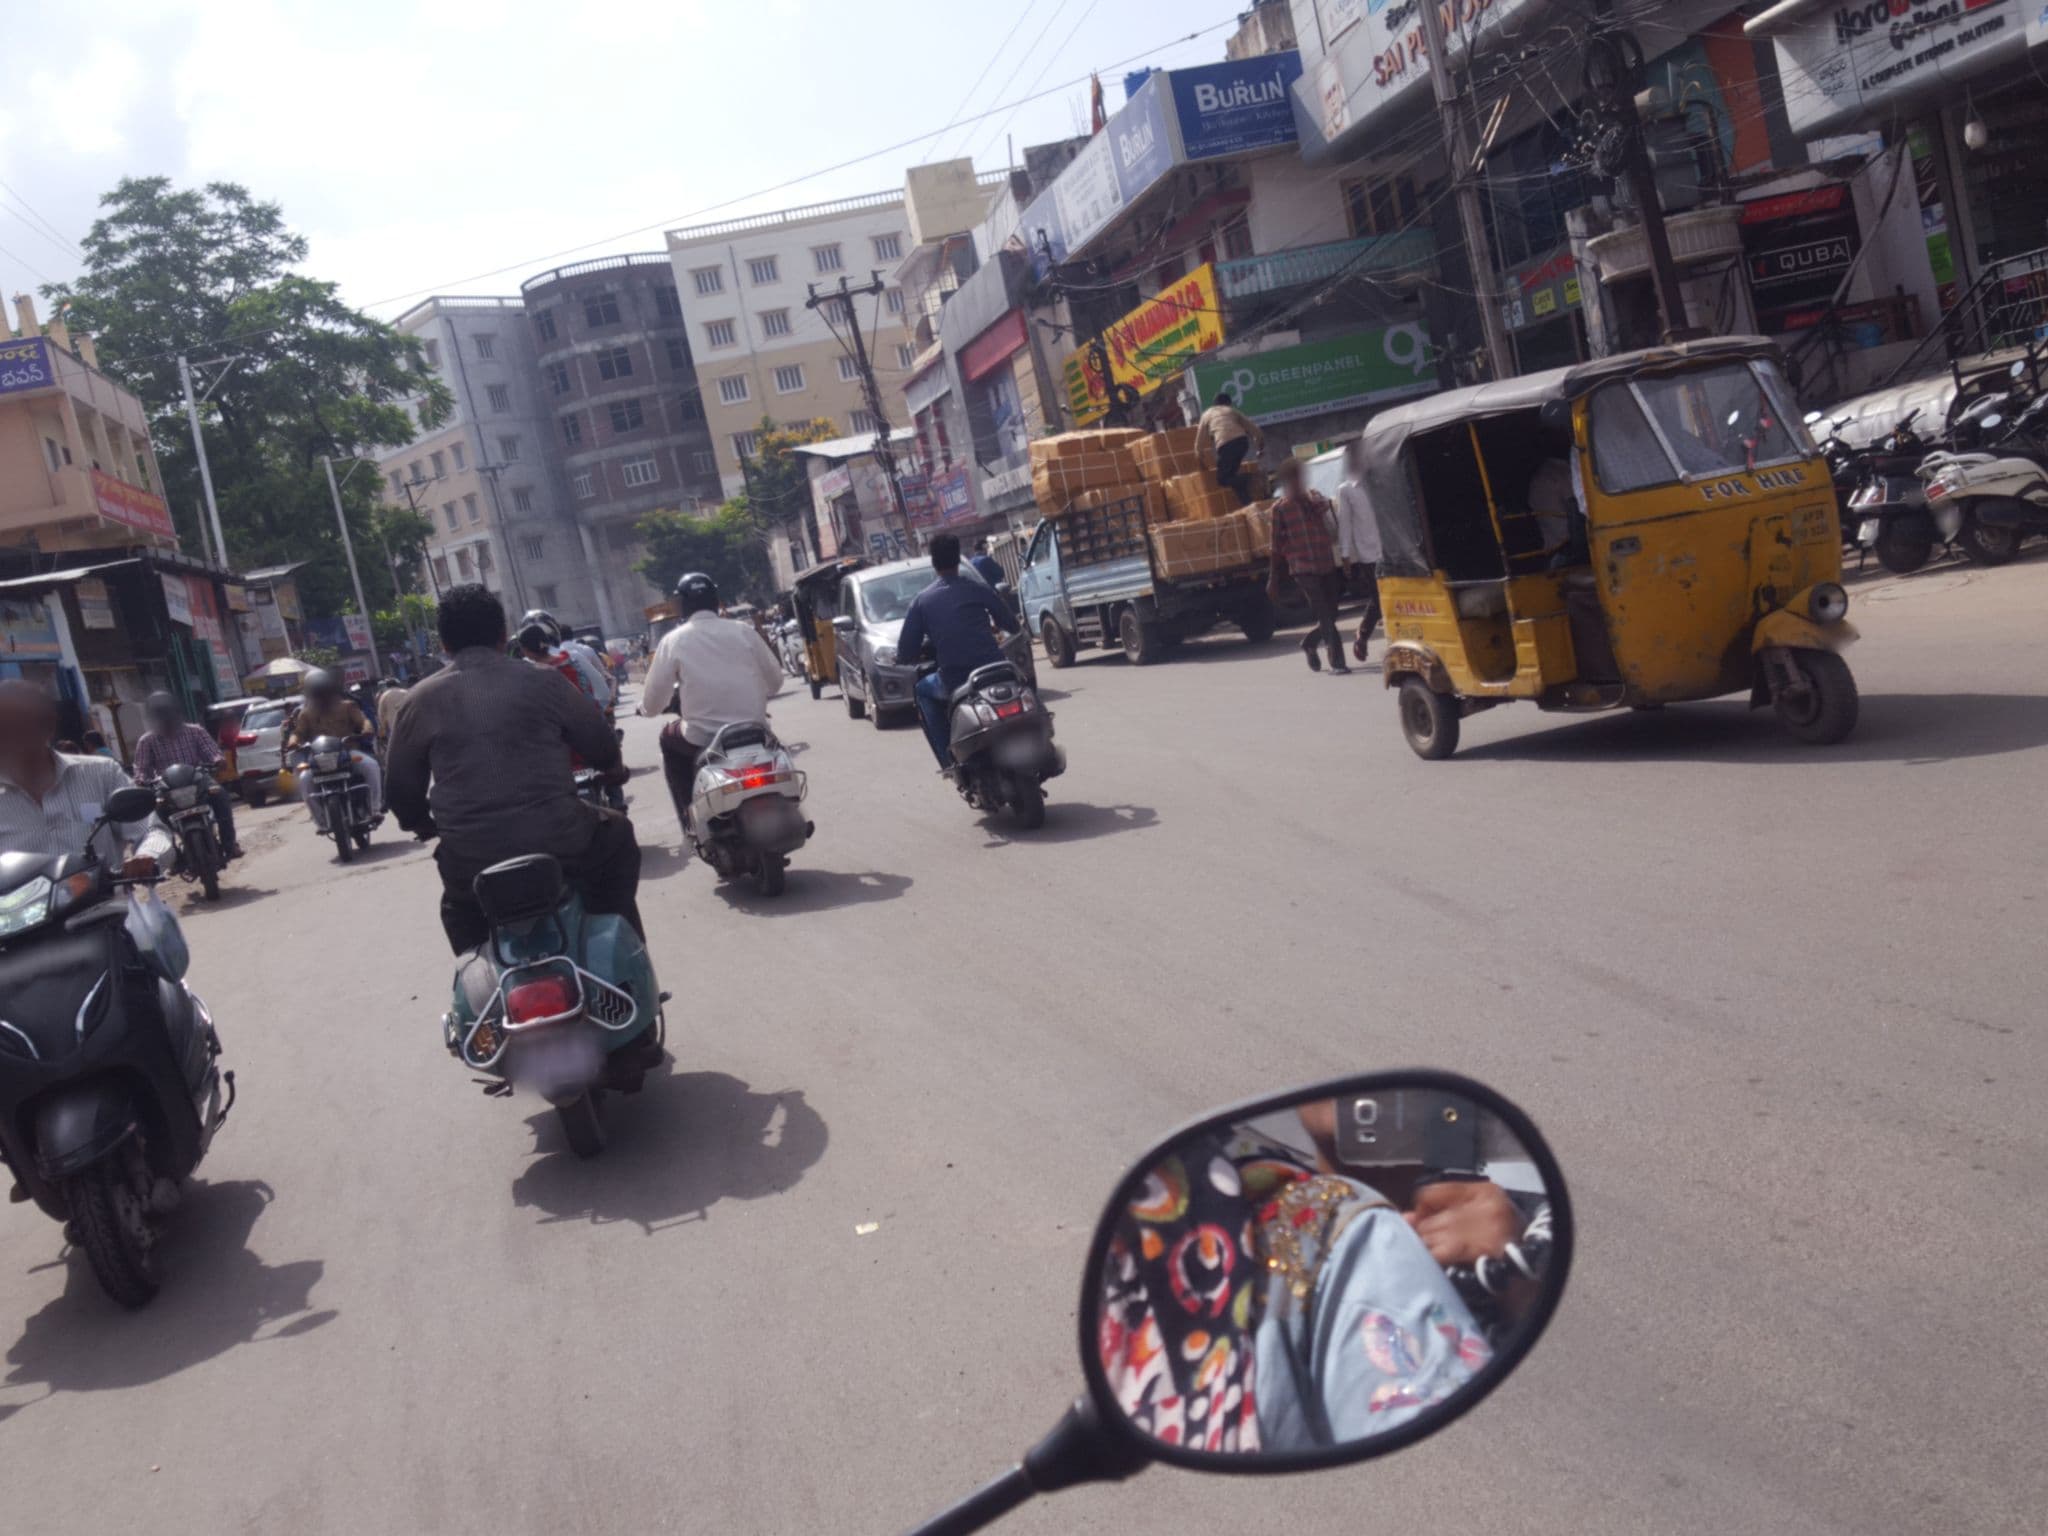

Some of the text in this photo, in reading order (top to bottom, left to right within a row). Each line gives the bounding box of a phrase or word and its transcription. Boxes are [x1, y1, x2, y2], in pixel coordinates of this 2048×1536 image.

[1373, 42, 1405, 87] SAI
[1869, 58, 1914, 87] COMPLETE
[1914, 38, 1955, 66] INTERIOR
[1957, 15, 2005, 46] SOLUTION
[1779, 244, 1847, 270] QUBA
[1257, 355, 1365, 386] GREENPANEL
[1701, 467, 1807, 502] FOR HIRE
